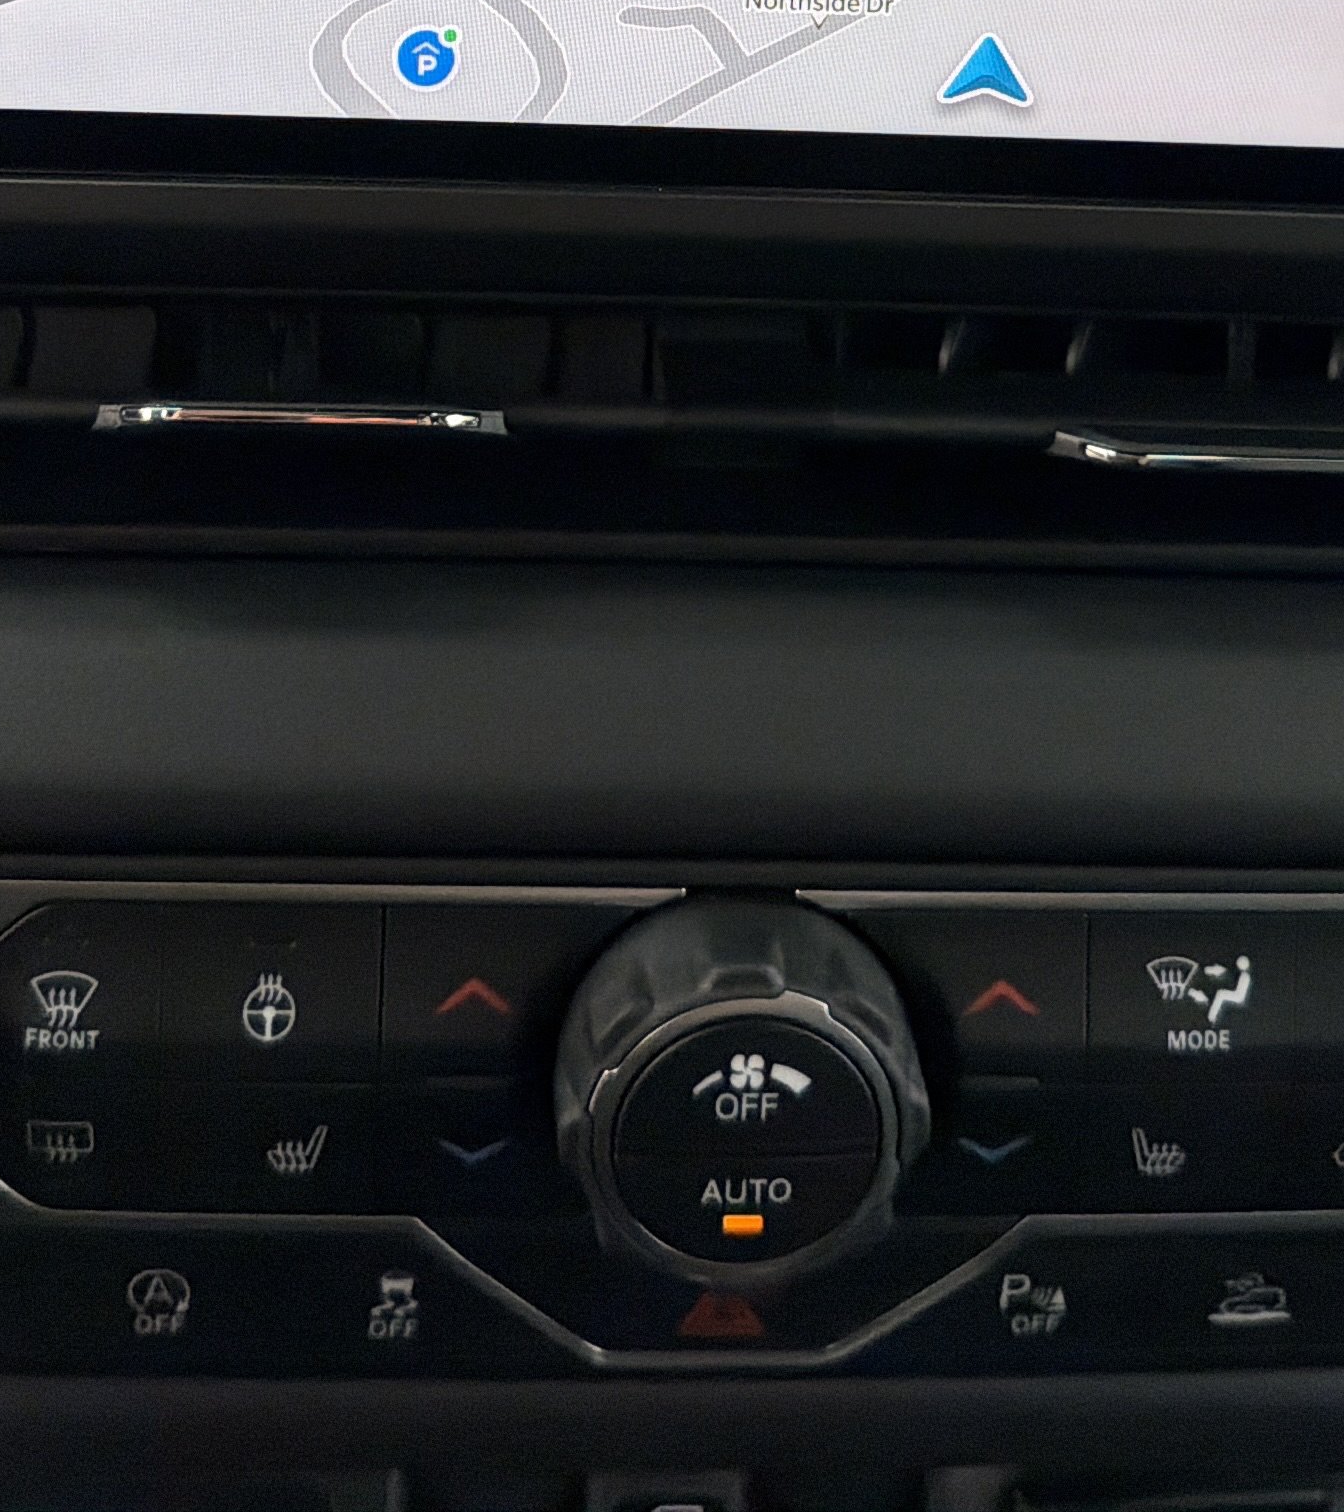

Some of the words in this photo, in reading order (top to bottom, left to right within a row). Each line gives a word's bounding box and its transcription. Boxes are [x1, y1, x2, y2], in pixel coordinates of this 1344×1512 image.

[25, 1028, 99, 1050] FRONT
[1167, 1031, 1230, 1051] MODE
[715, 1092, 778, 1122] OFF
[700, 1177, 792, 1206] AUTO
[134, 1314, 186, 1335] OFF
[368, 1317, 419, 1339] OFF
[1010, 1314, 1059, 1336] OFF
